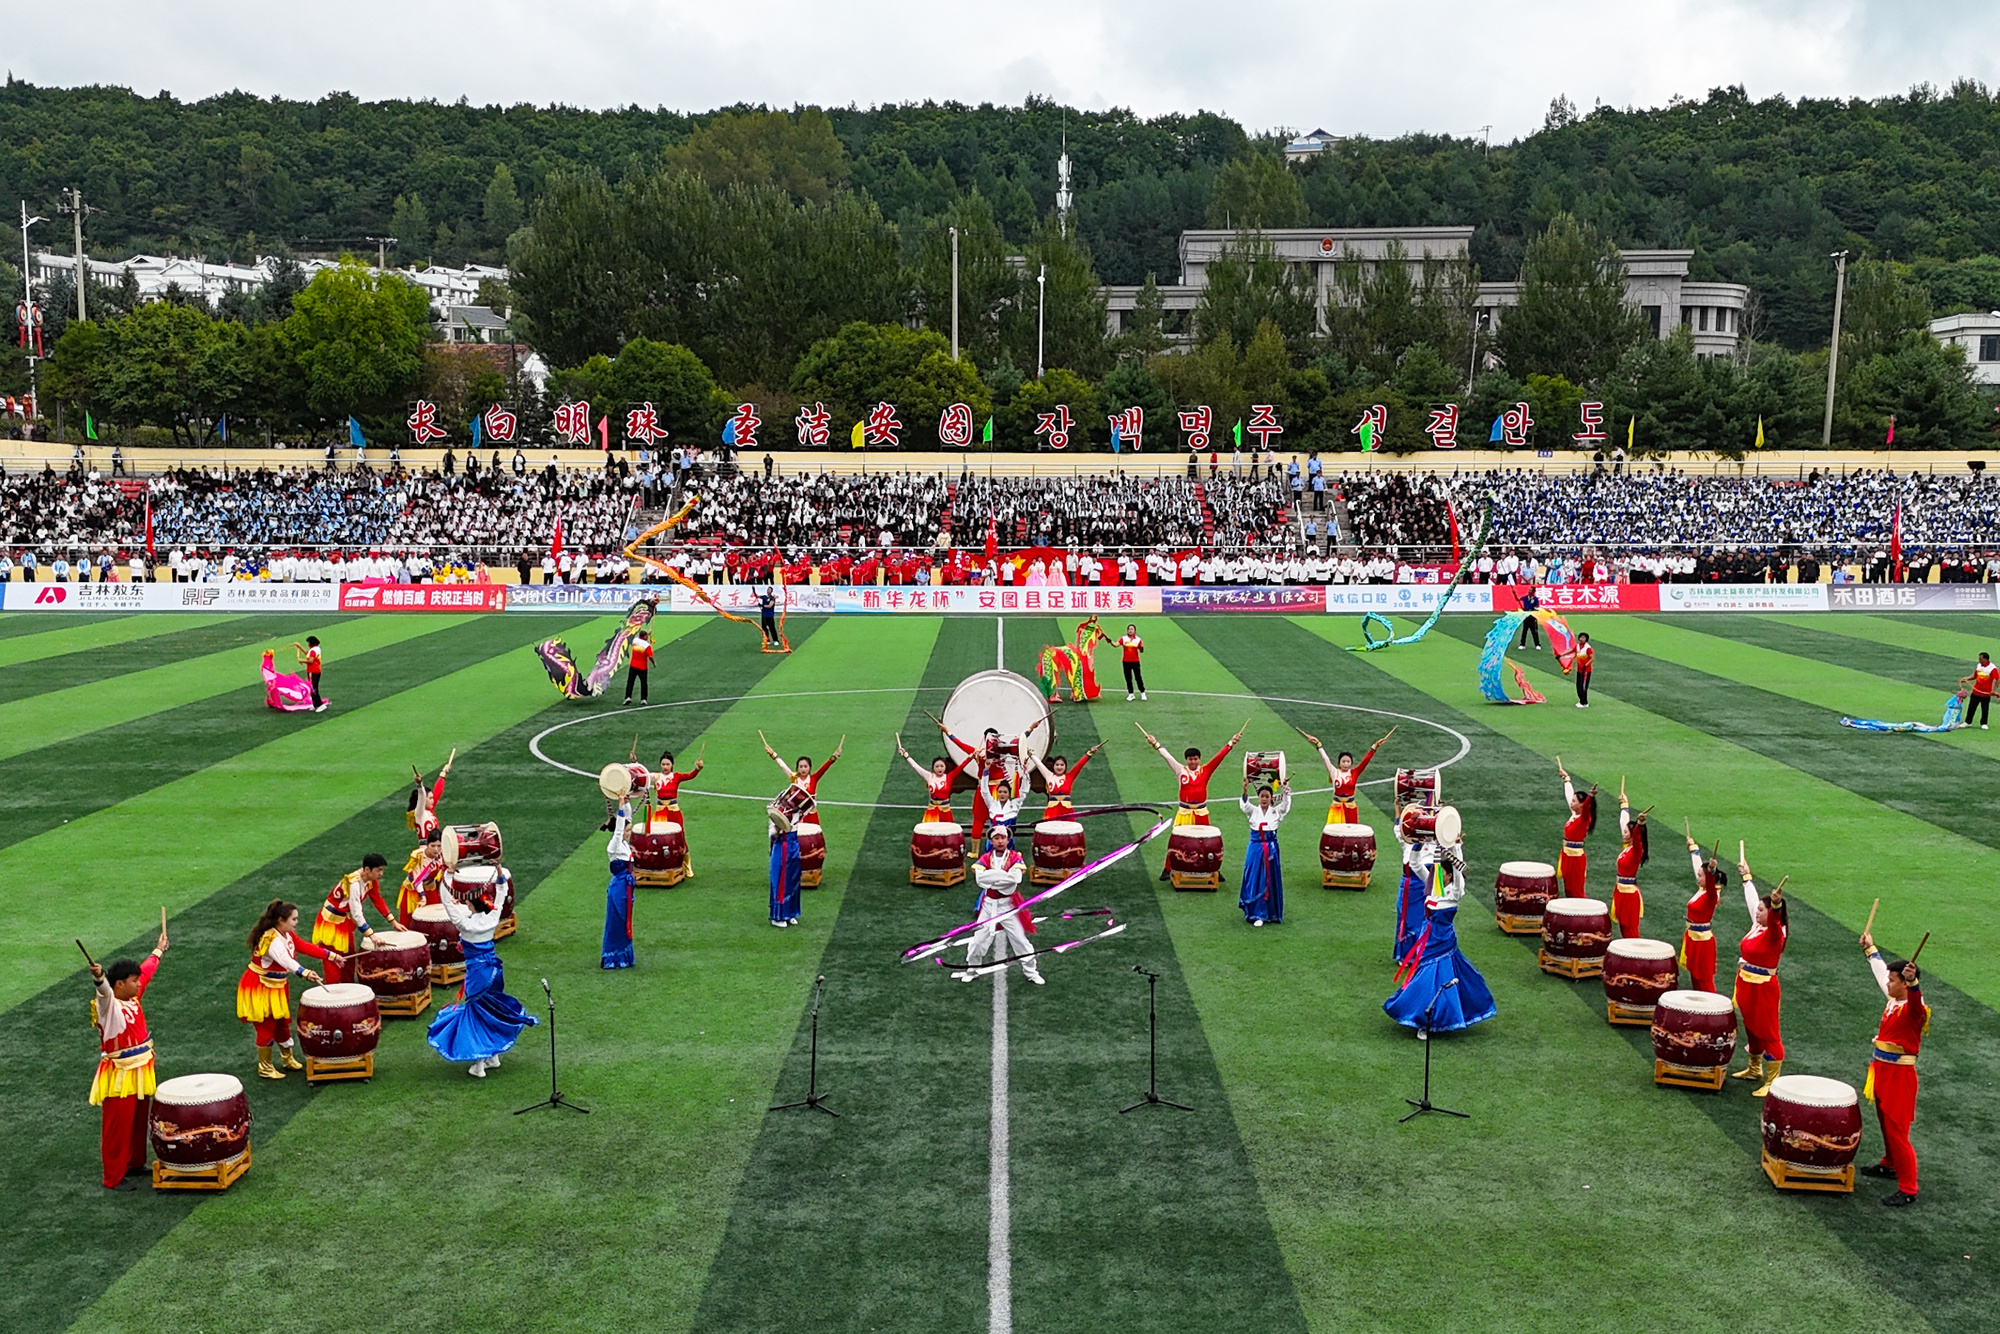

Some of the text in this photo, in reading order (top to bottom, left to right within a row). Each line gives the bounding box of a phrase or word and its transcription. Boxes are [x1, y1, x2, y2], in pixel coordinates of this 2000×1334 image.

[408, 400, 973, 446] 长白明珠 圣洁安图
[1035, 402, 1607, 450] 장백명주 성결안도
[79, 584, 144, 596] 吉林敖东
[382, 589, 484, 606] 燃情百威 庆祝正当时
[512, 589, 655, 604] 安图长白山天然矿泉水
[1170, 590, 1319, 605] 延边新华龙矿业有限公司
[1333, 593, 1388, 604] 诚信口腔
[1535, 585, 1620, 605] 東吉木源
[1833, 587, 1916, 606] 禾田酒店
[979, 590, 1134, 609] 安图县足球联赛
